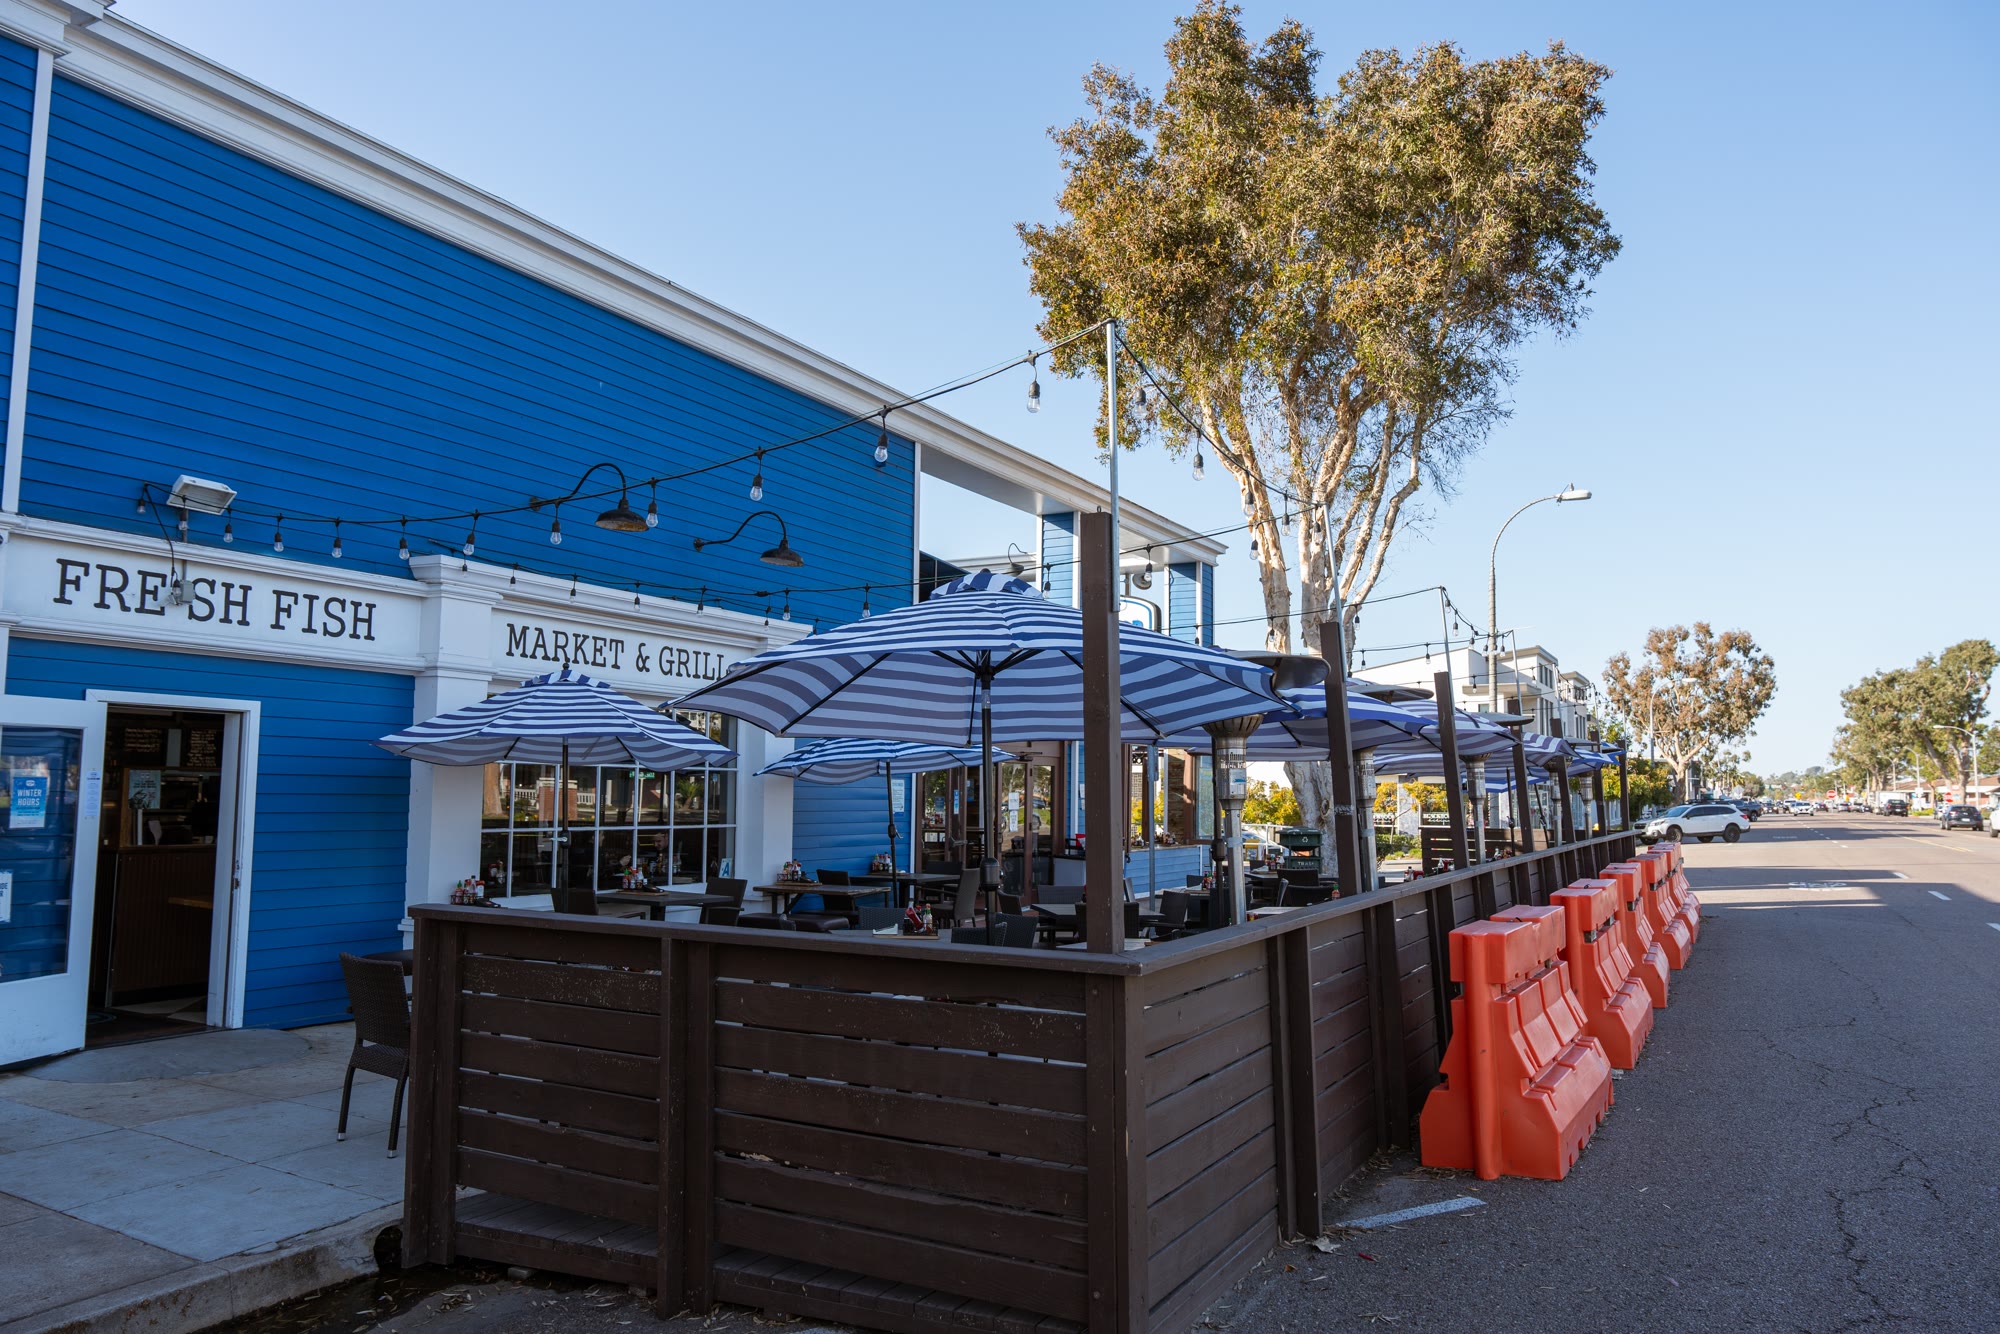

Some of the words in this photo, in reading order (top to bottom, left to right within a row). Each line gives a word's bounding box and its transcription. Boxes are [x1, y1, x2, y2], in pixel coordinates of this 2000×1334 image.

[53, 558, 252, 626] FRESH
[270, 589, 376, 641] FISH
[506, 623, 624, 669] MARKET
[636, 643, 650, 673] &
[659, 646, 730, 681] GRILL
[17, 789, 42, 797] WINTER
[17, 798, 40, 806] HOURS
[722, 862, 730, 876] A
